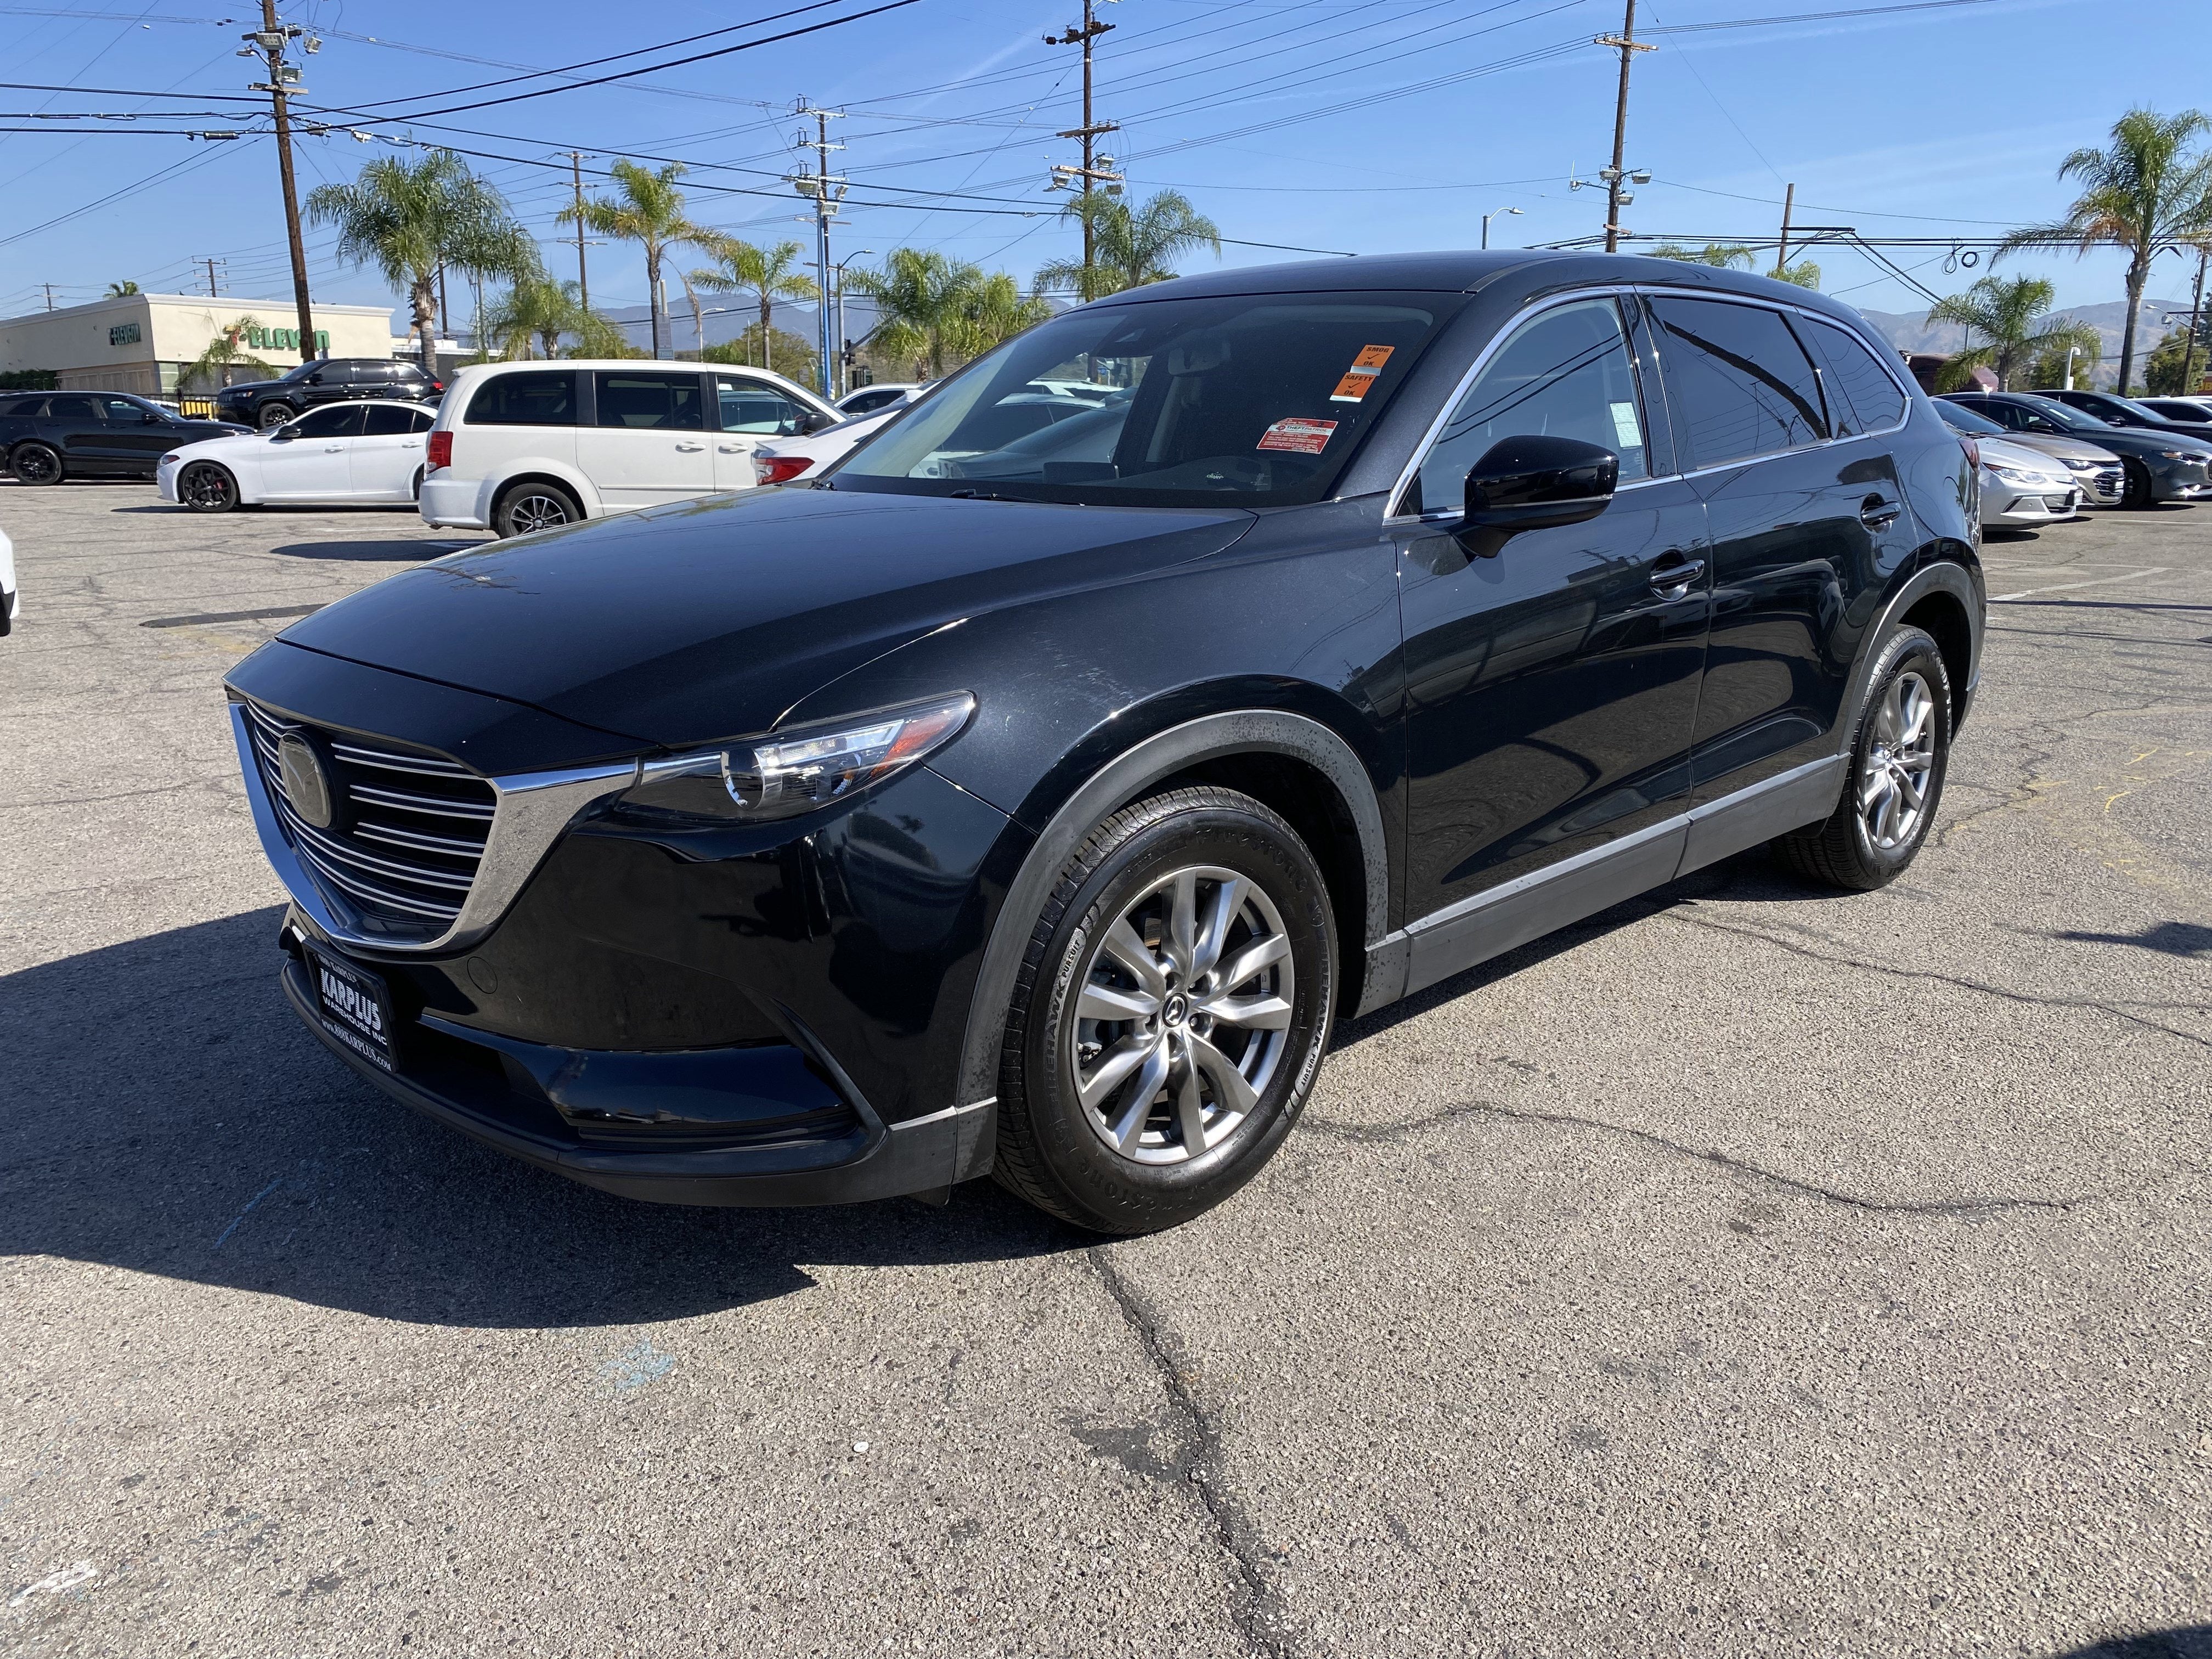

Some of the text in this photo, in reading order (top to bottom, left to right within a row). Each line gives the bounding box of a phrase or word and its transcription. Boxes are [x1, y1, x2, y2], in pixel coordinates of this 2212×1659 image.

[1062, 939, 1080, 978] PURSUIT
[320, 968, 381, 1031] KARPLUS
[323, 995, 387, 1046] WAREHOUSE INC
[1302, 1053, 1316, 1087] PURSUIT
